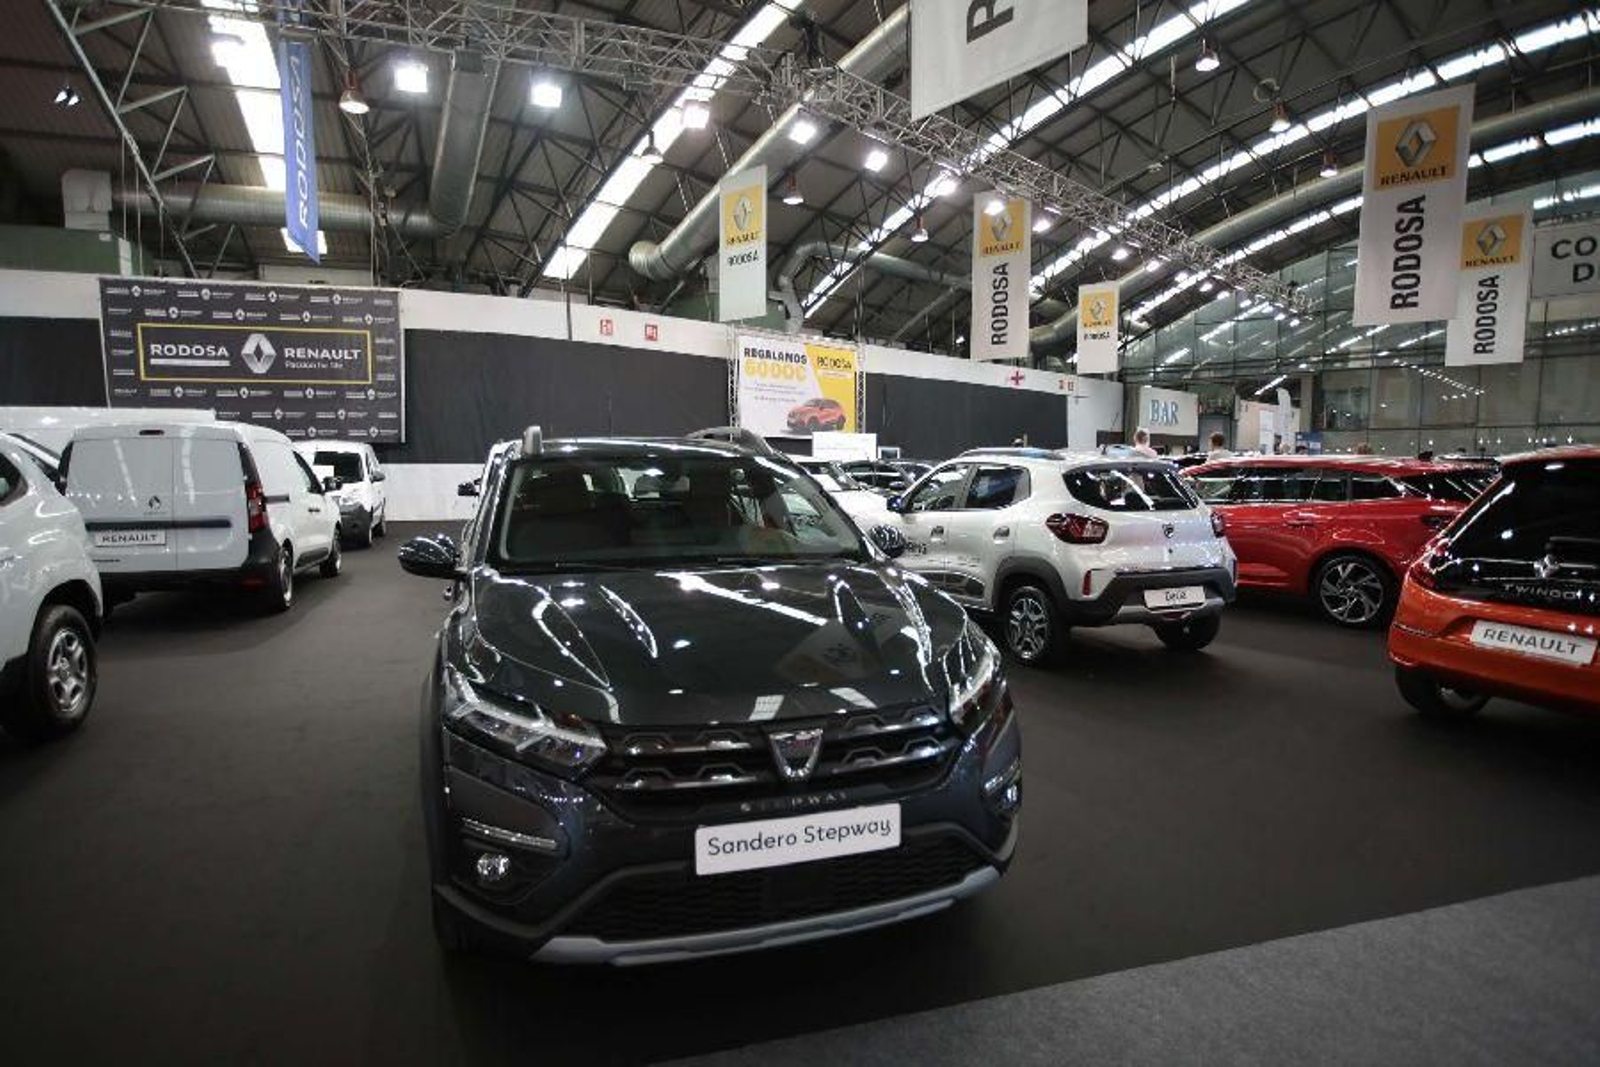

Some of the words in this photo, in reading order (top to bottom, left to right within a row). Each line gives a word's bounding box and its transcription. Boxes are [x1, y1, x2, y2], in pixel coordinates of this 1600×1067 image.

[966, 0, 1014, 44] R
[289, 55, 309, 230] RODOSA
[1380, 166, 1448, 185] RENAULT
[1390, 195, 1427, 309] RODOSA
[1465, 255, 1516, 267] RENAULT
[1550, 236, 1600, 260] CO
[1572, 262, 1600, 284] D
[990, 262, 1010, 345] RODOSA
[1473, 275, 1501, 354] RODOSA
[149, 344, 230, 357] RODOSA
[284, 347, 362, 360] RENAULT
[1151, 399, 1180, 427] BAR
[102, 534, 157, 543] RENAULT
[1483, 628, 1581, 656] RENAULT
[707, 832, 798, 856] Sandero
[804, 818, 892, 844] Stepway
